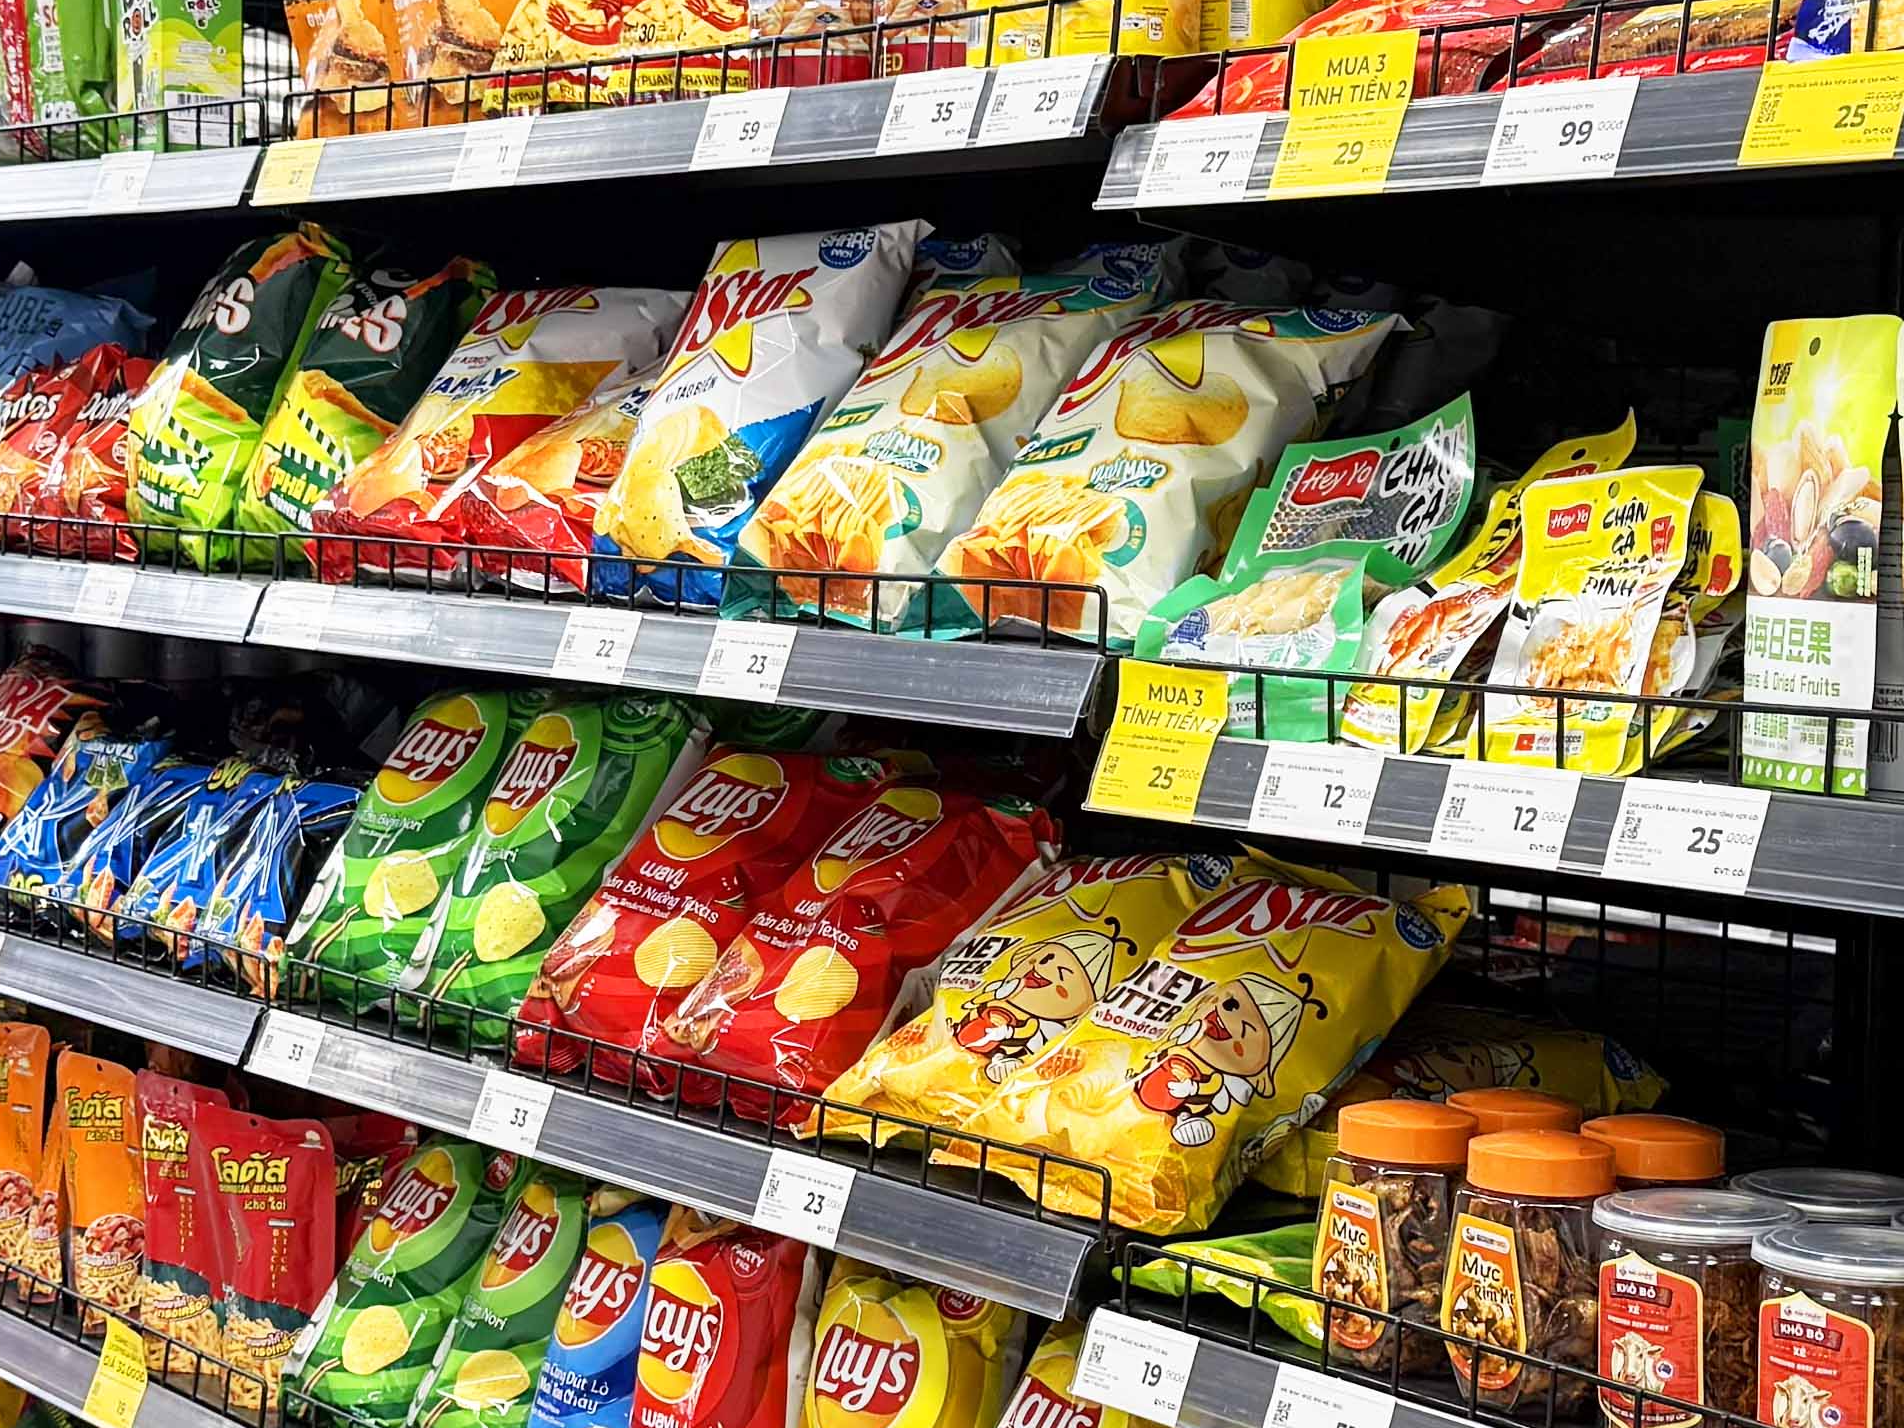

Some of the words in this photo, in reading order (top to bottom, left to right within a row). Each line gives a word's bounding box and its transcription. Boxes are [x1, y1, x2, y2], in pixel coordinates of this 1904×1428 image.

[1327, 56, 1368, 77] MUA
[1374, 55, 1386, 76] 3
[1299, 83, 1340, 106] TÍNH
[1347, 76, 1391, 103] TIỀN
[1396, 76, 1407, 98] 2
[931, 100, 955, 124] 35
[1559, 120, 1593, 148] 99
[1199, 150, 1230, 173] 27
[1334, 141, 1364, 166] 29
[1302, 464, 1338, 492] Hey
[1340, 463, 1373, 487] Yo
[1323, 784, 1345, 808] 12
[671, 783, 785, 842] Lay's
[1686, 827, 1723, 855] 25
[802, 1192, 823, 1214] 23
[1332, 1217, 1366, 1250] Mực
[817, 1325, 919, 1412] Lay's
[1141, 1360, 1162, 1387] 19
